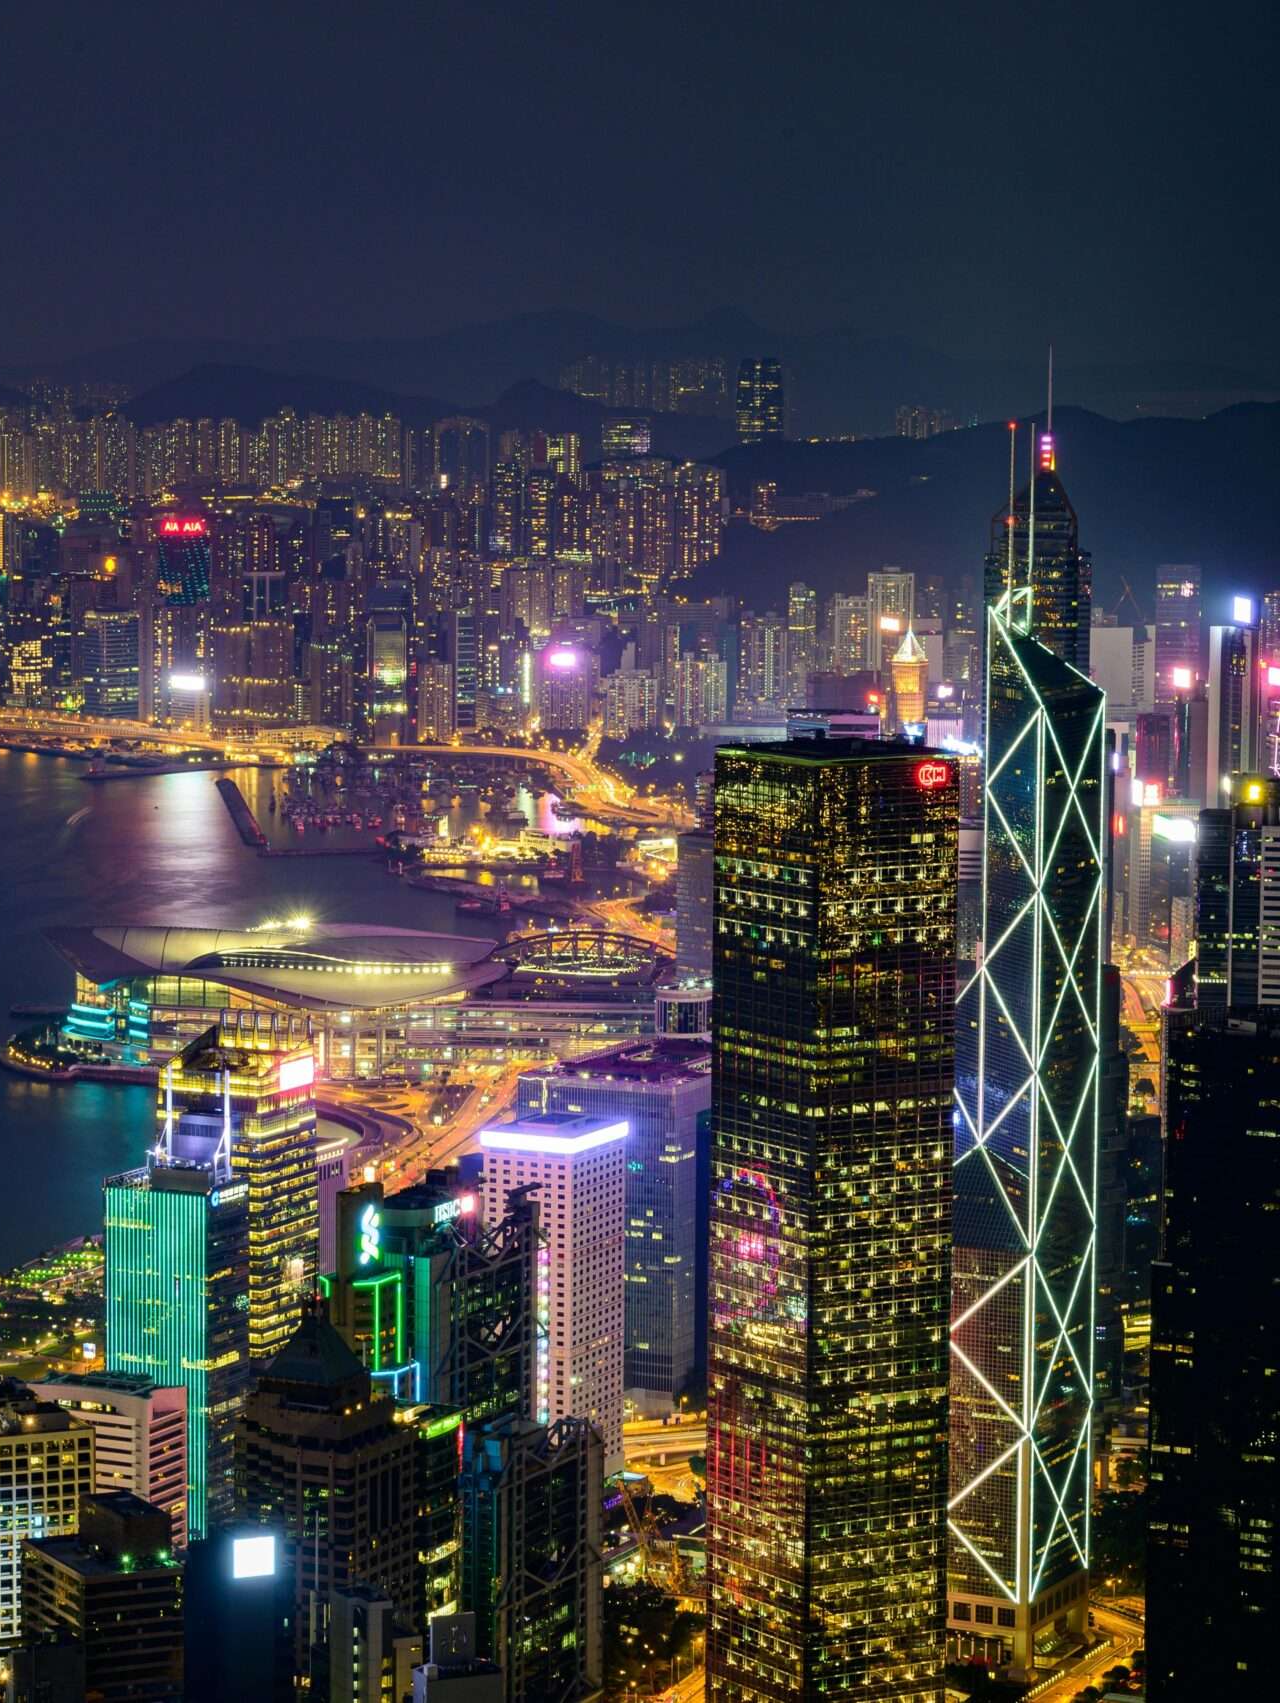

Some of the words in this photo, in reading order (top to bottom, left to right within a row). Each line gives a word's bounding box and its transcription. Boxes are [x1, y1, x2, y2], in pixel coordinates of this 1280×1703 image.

[164, 522, 179, 532] AIA
[183, 522, 202, 532] AIA
[433, 1198, 461, 1224] HSBC
